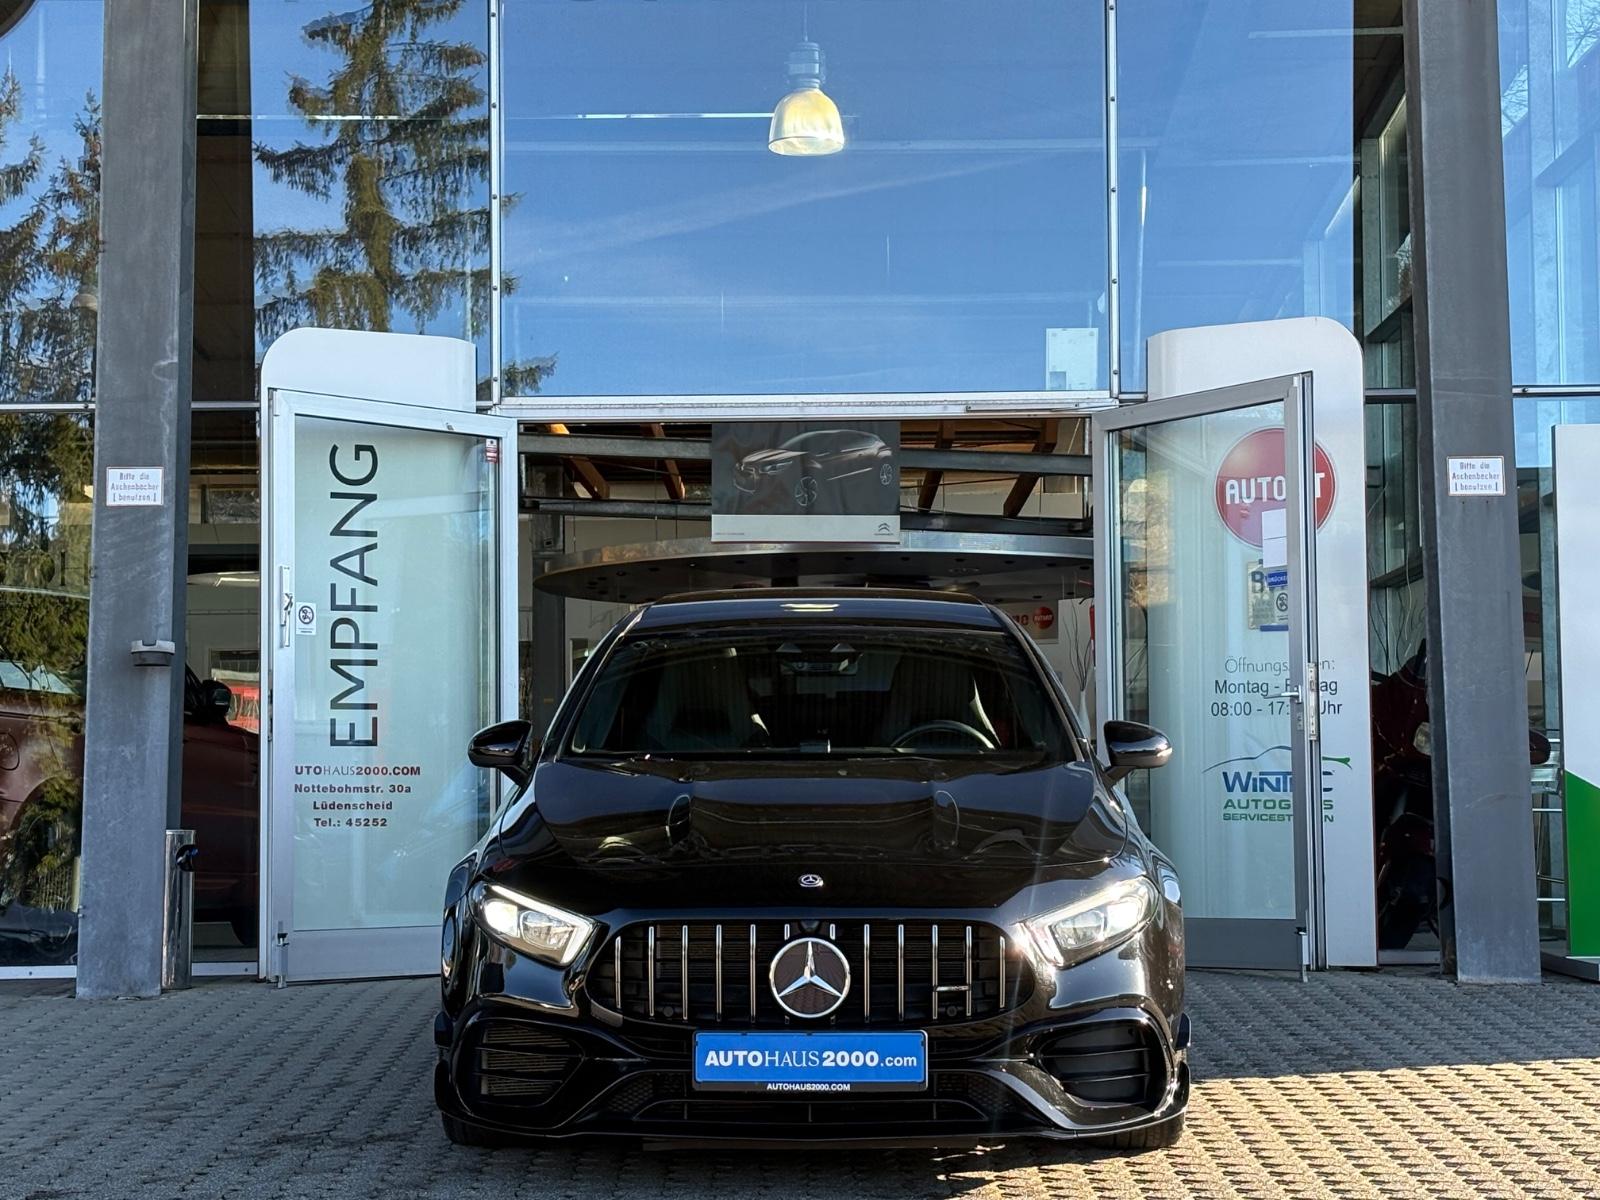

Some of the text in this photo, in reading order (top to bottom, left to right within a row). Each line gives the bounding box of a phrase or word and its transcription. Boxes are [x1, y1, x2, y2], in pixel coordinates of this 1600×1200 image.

[1225, 472, 1325, 505] AUTOT
[329, 444, 378, 746] EMPFANG
[1225, 656, 1335, 676] Öffnungsn:
[1214, 679, 1269, 696] Montag
[1211, 701, 1252, 716] 08:00
[1268, 701, 1290, 715] 17:
[294, 765, 421, 776] UTOHAUS2000.COM
[294, 784, 412, 793] Nottebohmstr. 30a
[313, 801, 393, 810] Lüdenscheid
[1223, 799, 1334, 811] AUTOGS
[314, 818, 388, 827] Tel.: 45252
[1223, 813, 1334, 823] SERVICESTN
[766, 1083, 851, 1091] AUTOHAUS2000.COM
